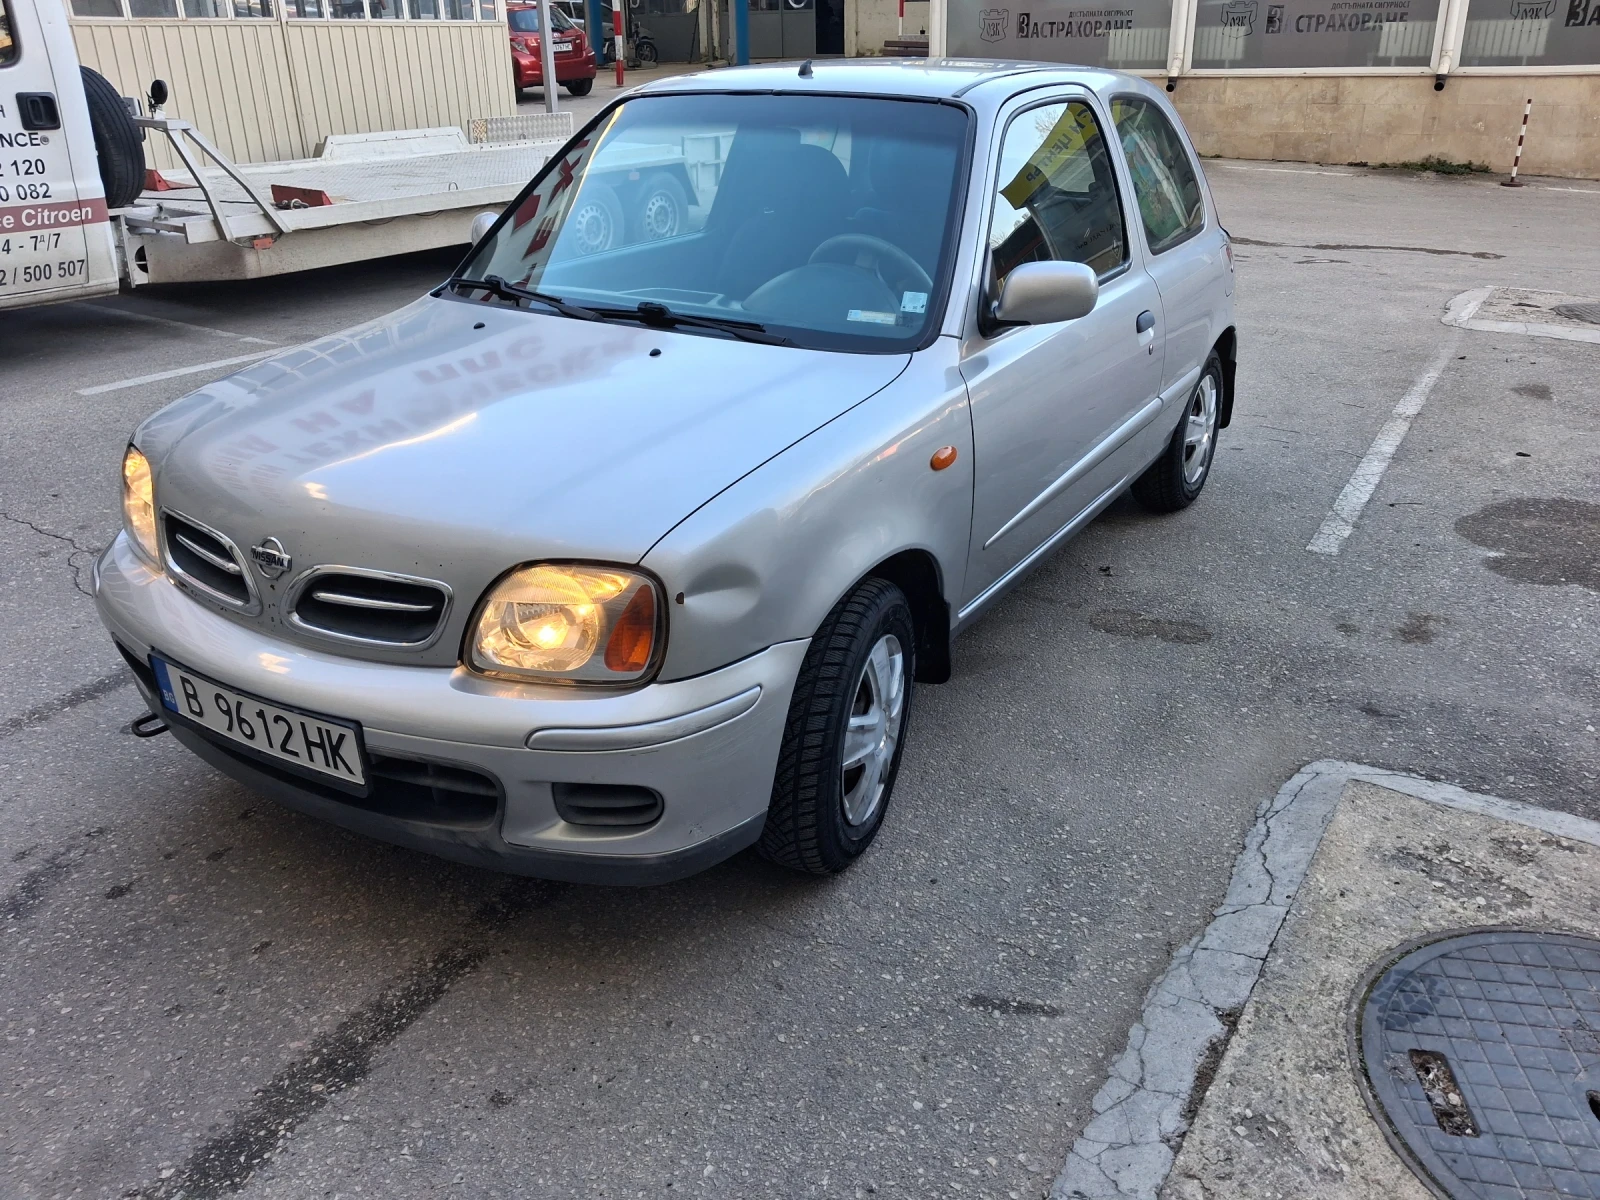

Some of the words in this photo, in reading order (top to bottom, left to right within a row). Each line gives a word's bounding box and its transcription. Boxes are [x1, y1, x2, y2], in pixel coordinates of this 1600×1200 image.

[10, 158, 46, 176] 120
[15, 182, 52, 201] 082
[21, 205, 92, 226] Citroen
[23, 263, 52, 283] 500
[58, 259, 85, 278] 507
[252, 550, 285, 567] NISSAN
